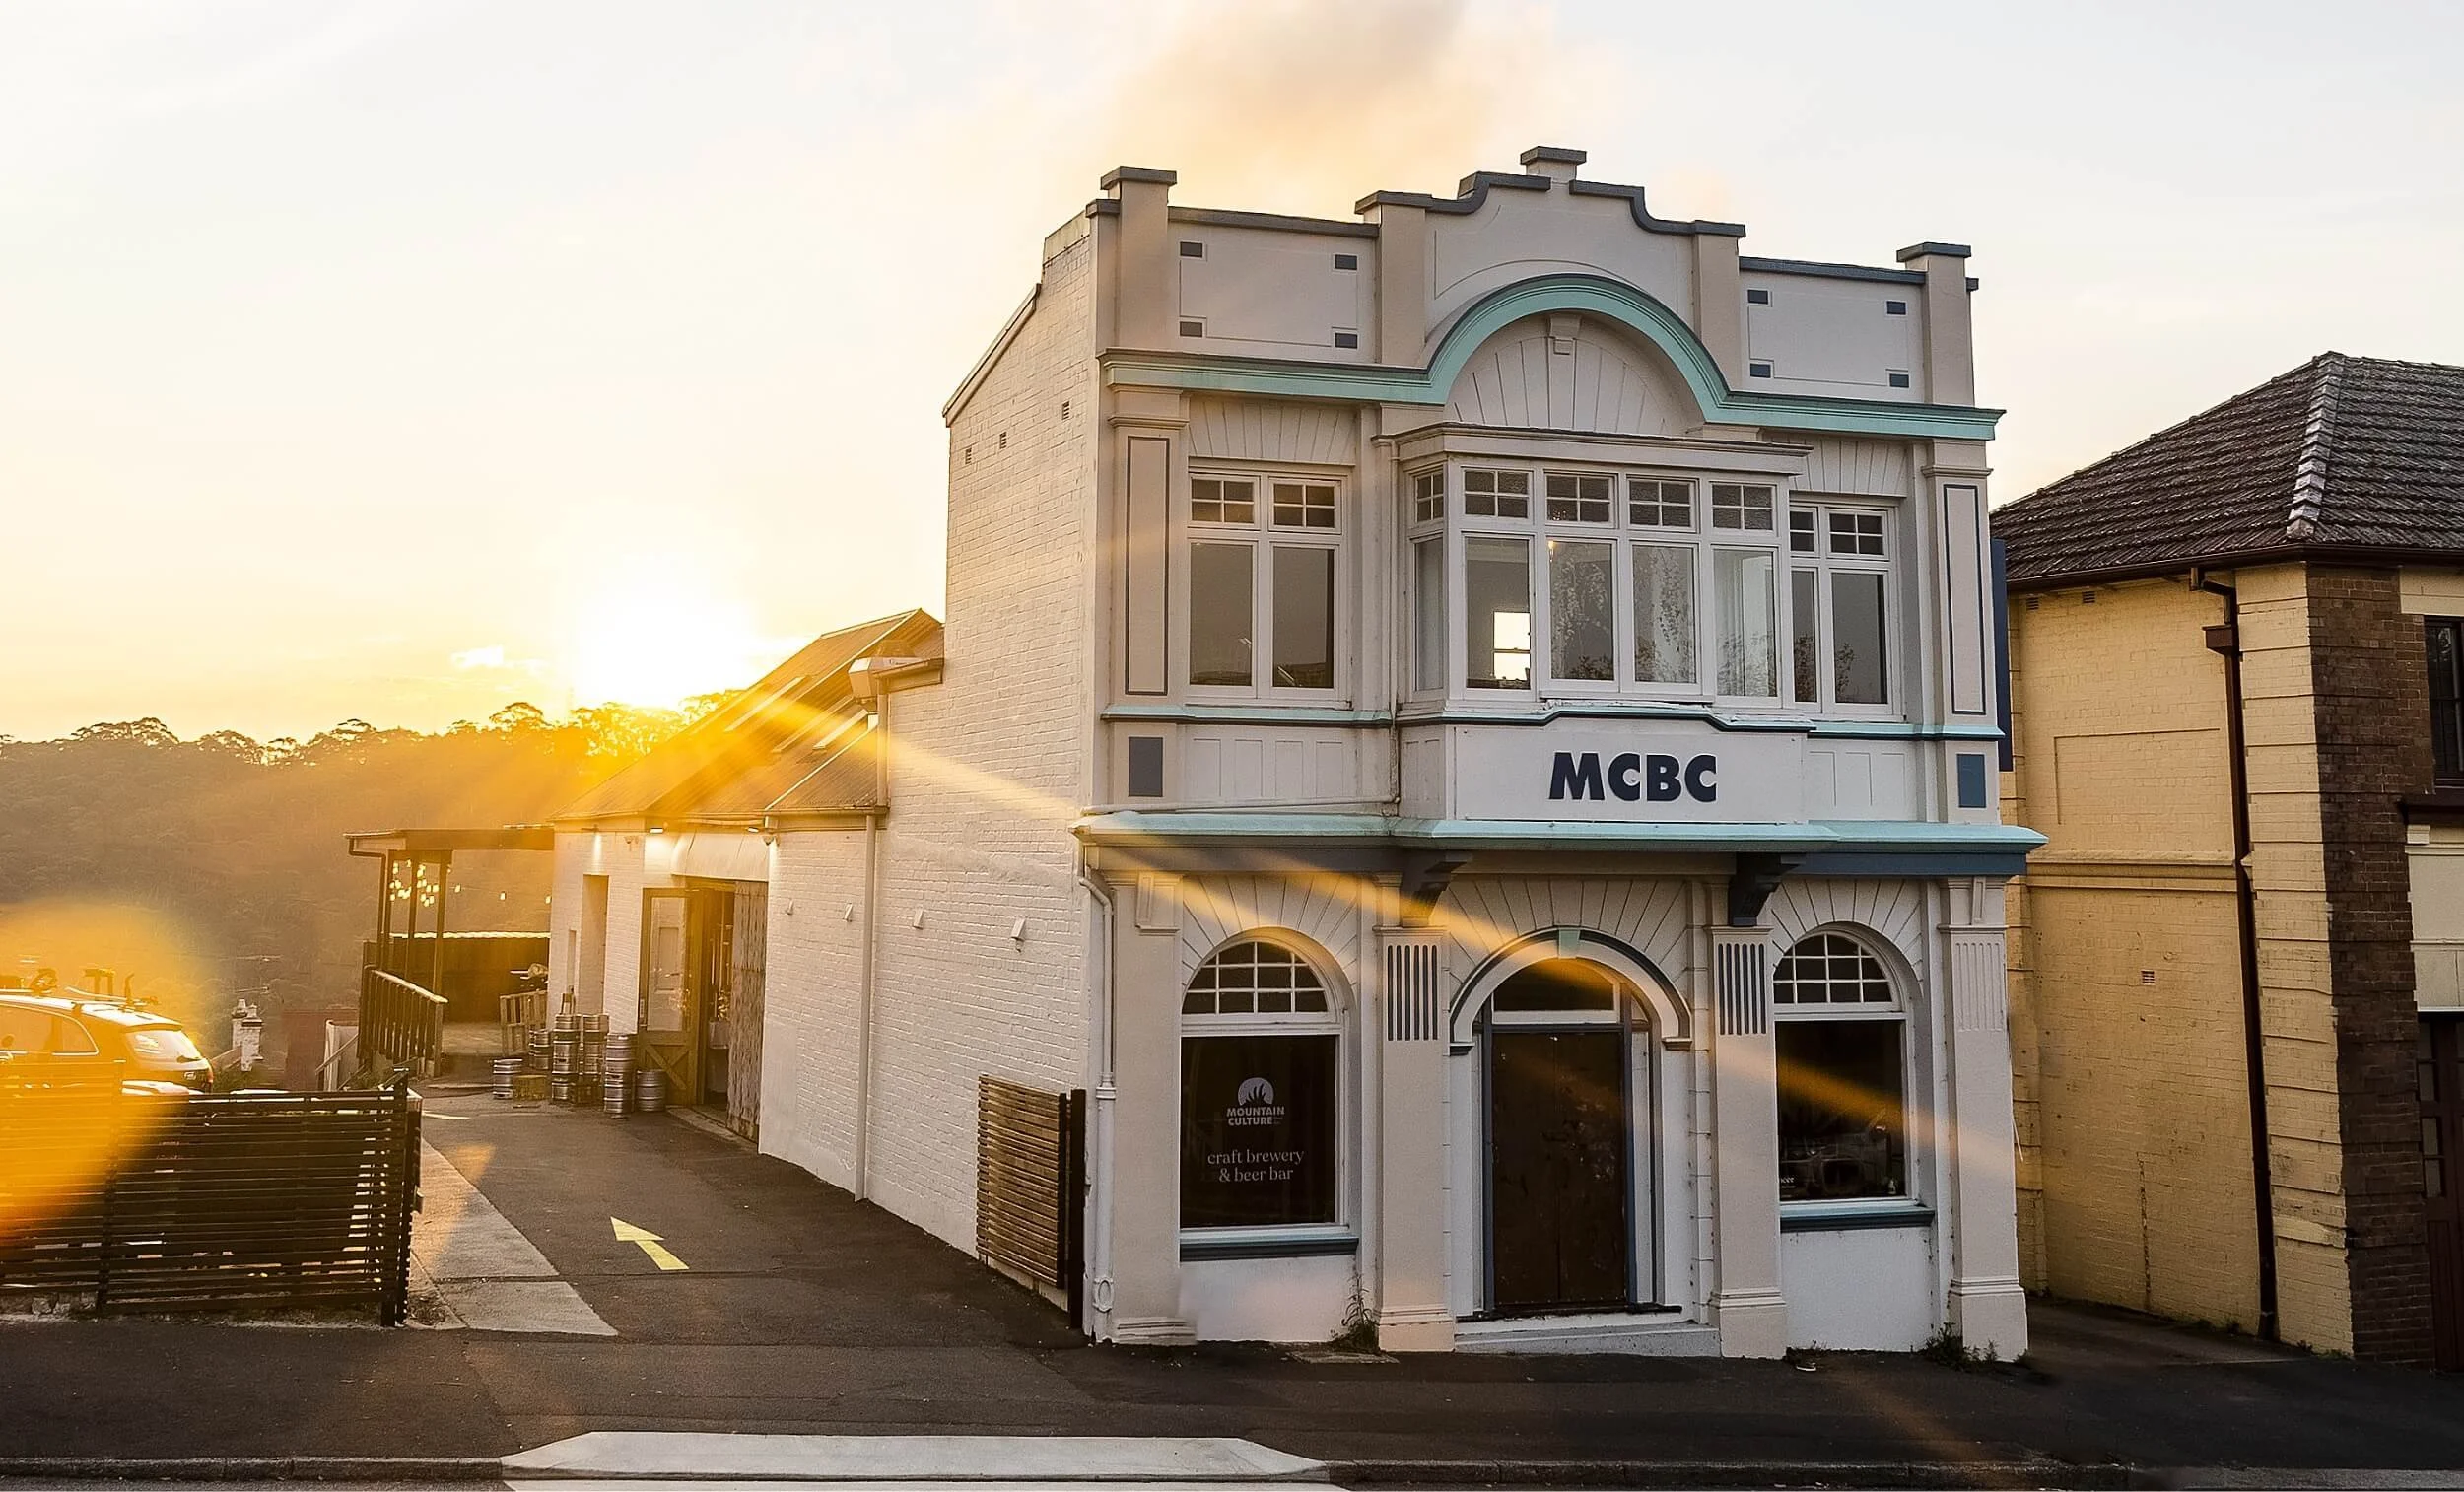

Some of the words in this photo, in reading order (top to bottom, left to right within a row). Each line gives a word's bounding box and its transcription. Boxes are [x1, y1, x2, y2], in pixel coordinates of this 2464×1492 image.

[1548, 751, 1717, 803] MCBC
[1226, 1106, 1285, 1117] MOUNTAIN
[1228, 1117, 1273, 1126] CULTURE
[1207, 1149, 1243, 1165] craft
[1246, 1149, 1304, 1166] brewery
[1218, 1167, 1231, 1183] &
[1234, 1166, 1266, 1182] beer
[1268, 1166, 1294, 1181] bar
